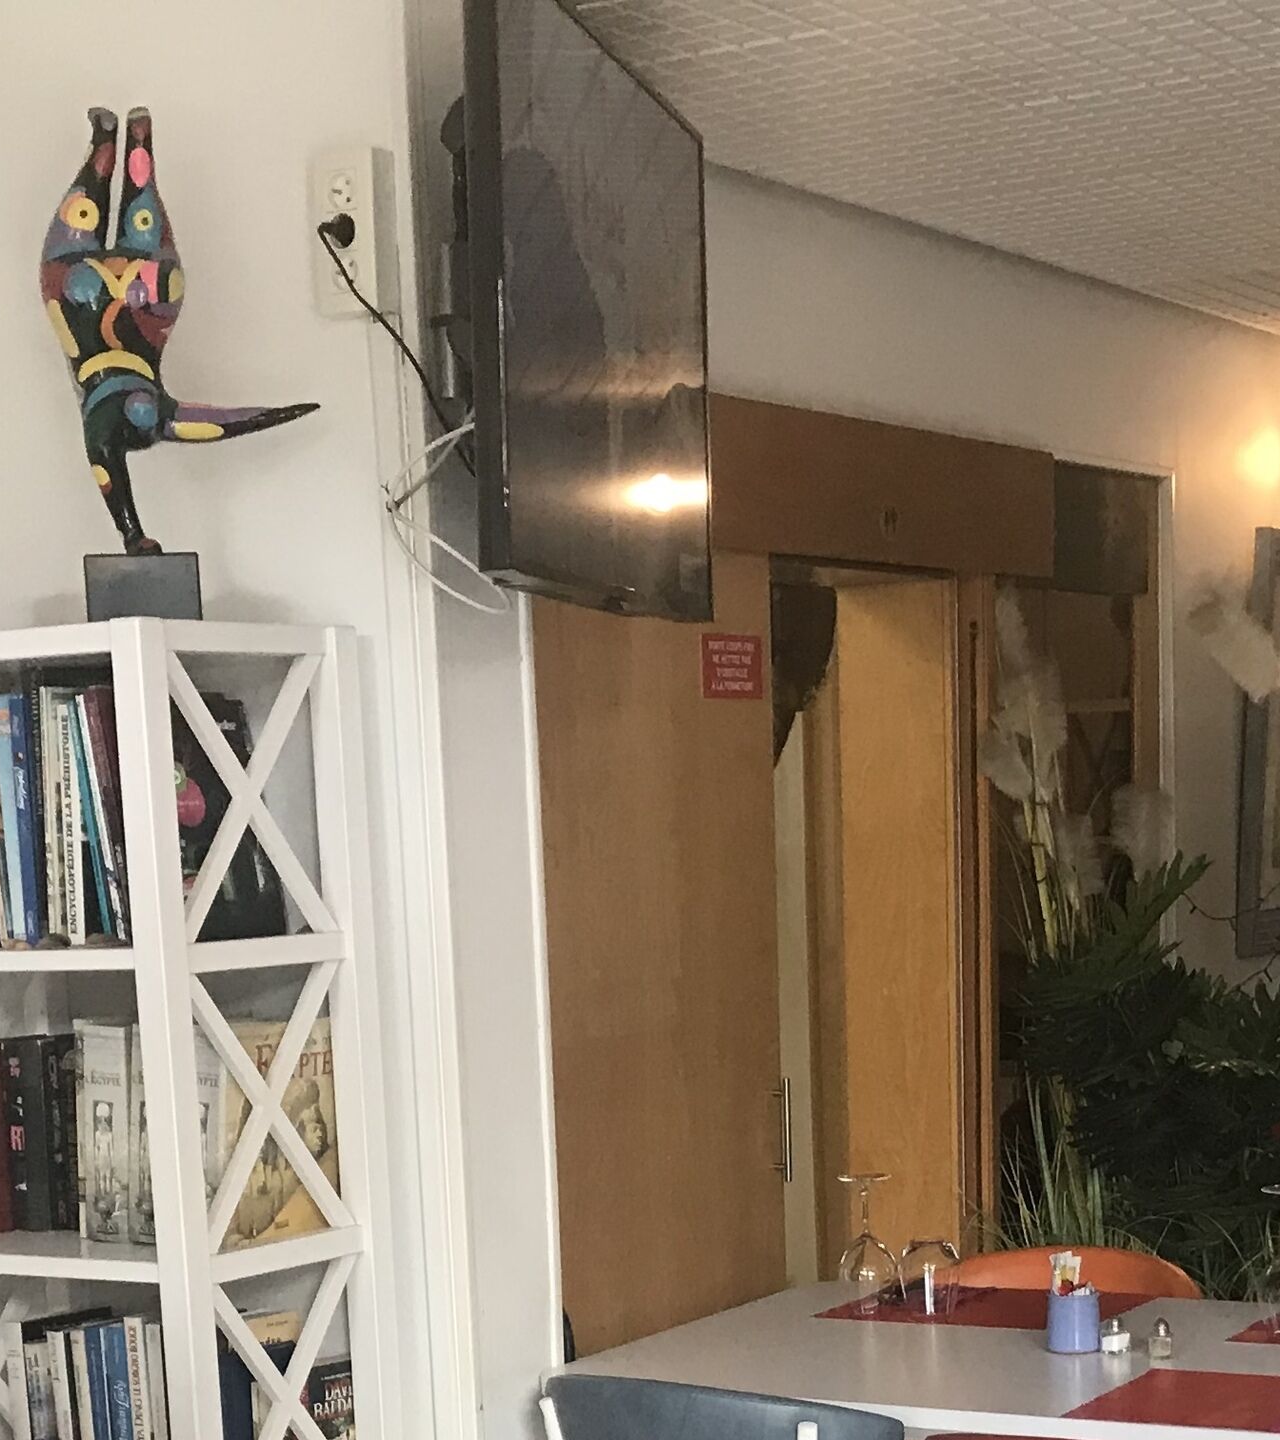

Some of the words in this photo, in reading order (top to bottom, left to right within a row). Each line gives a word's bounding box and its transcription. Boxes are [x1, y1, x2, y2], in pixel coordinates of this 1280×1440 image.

[61, 714, 73, 801] PRÉHISTOIRE
[63, 807, 73, 823] LA
[64, 825, 74, 840] DE
[64, 842, 80, 935] ENCYCLOPÉDIE
